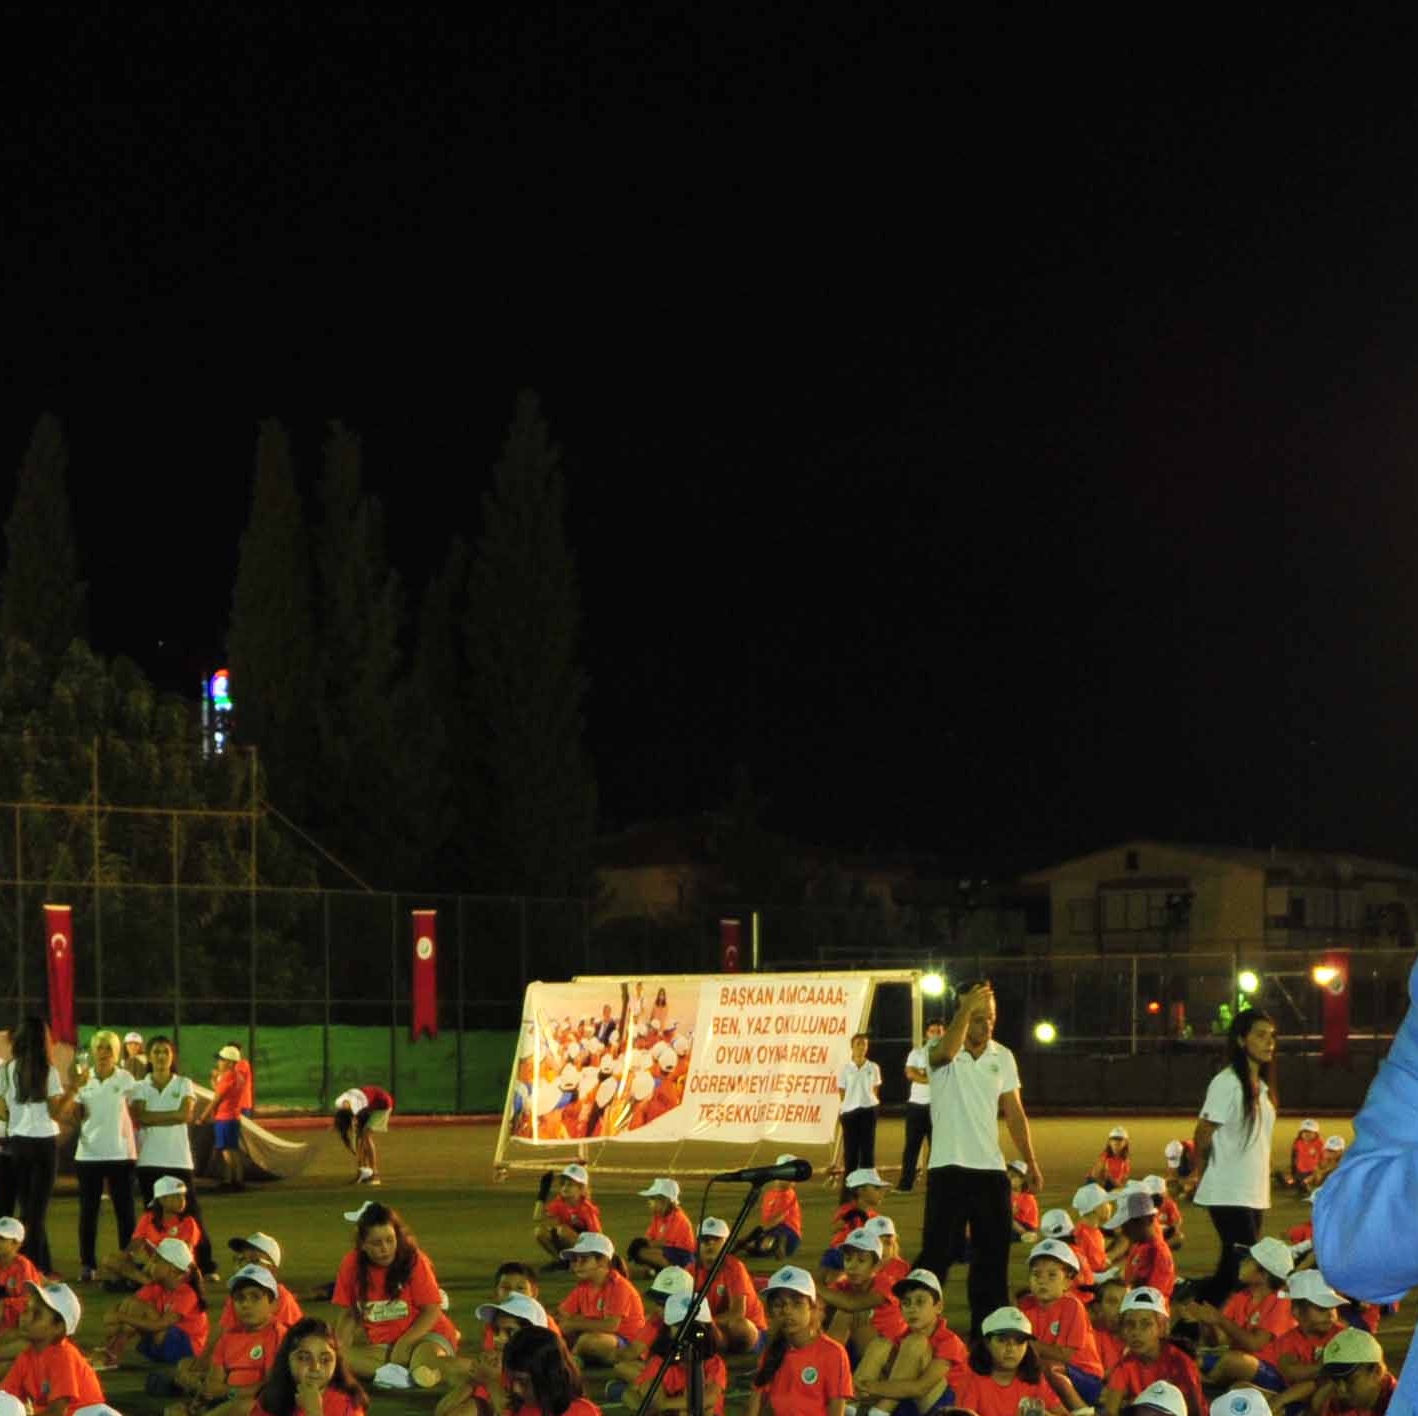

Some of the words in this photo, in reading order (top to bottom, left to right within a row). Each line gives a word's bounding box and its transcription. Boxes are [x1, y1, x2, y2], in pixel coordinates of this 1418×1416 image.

[719, 986, 774, 1010] BAŞKAN
[712, 1016, 741, 1038] BEN,
[746, 1016, 771, 1034] YAZ
[775, 1015, 847, 1034] OKULUNDA
[715, 1045, 752, 1065] OYUN
[756, 1045, 829, 1065] OYNARKEN
